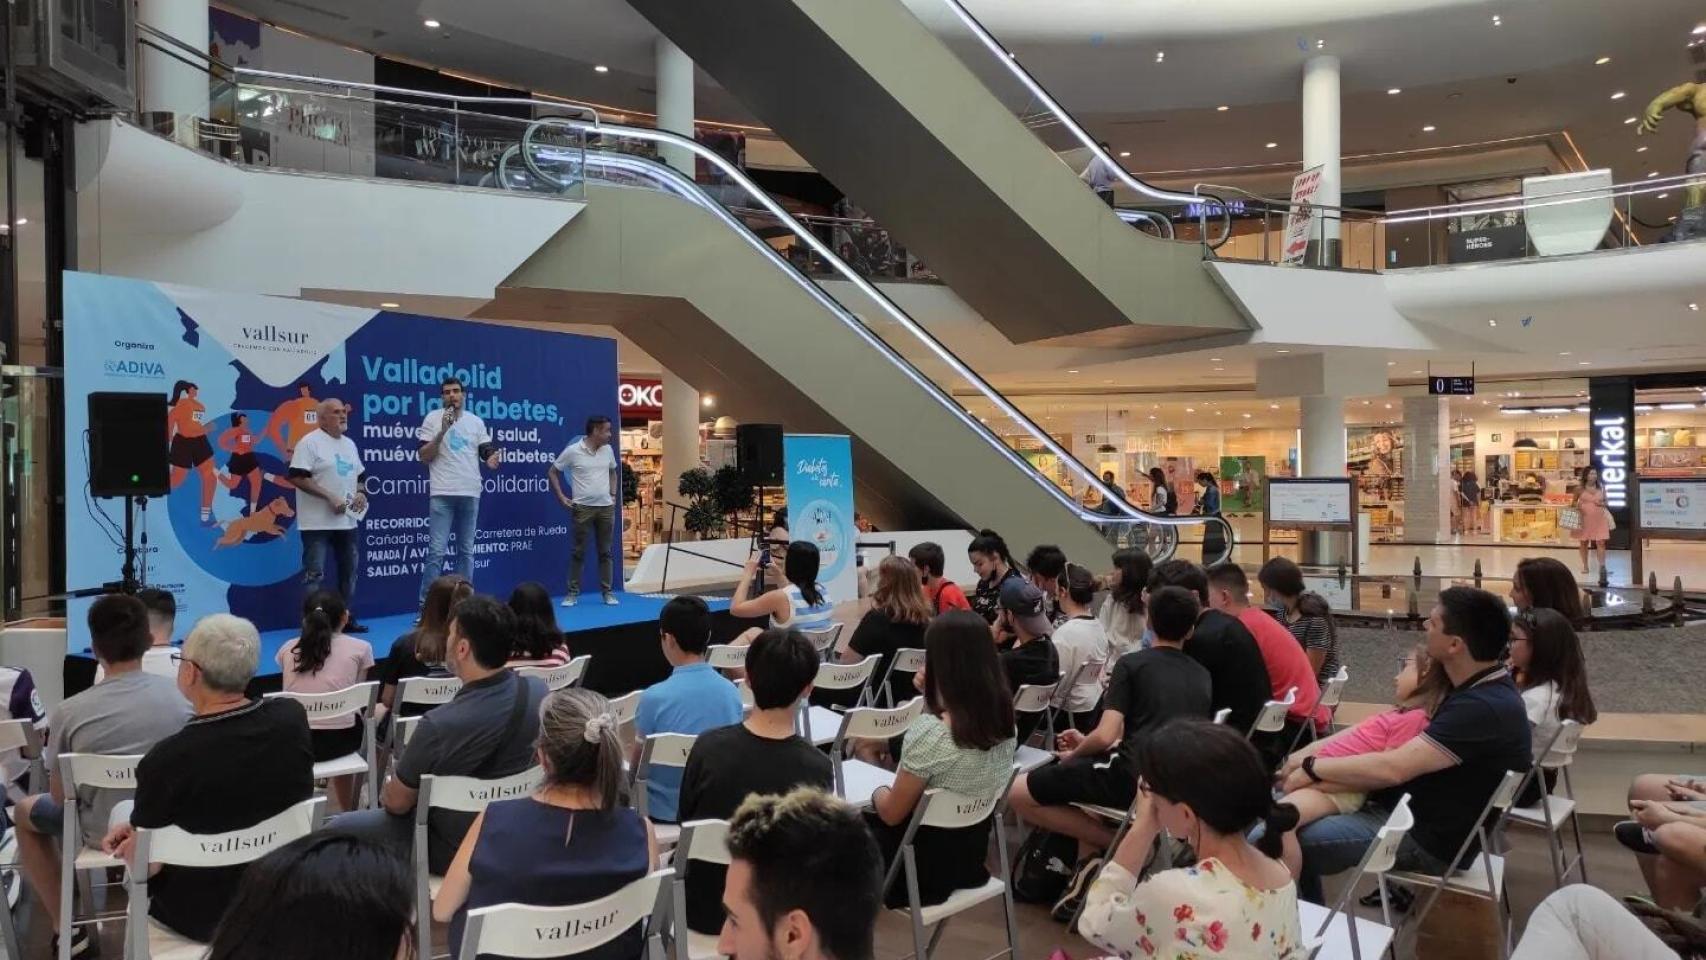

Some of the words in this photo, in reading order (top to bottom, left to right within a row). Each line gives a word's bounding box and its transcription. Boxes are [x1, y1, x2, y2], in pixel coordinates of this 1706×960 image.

[242, 325, 309, 344] vallsur
[114, 340, 155, 351] Organiza
[361, 355, 502, 391] Valladolid
[1436, 378, 1445, 393] 0
[363, 393, 413, 423] por
[466, 393, 564, 426] iabetes,
[363, 421, 423, 438] muéve
[497, 427, 541, 444] salud,
[1594, 416, 1626, 506] merkal
[366, 532, 414, 546] Cañada
[474, 528, 522, 539] Carretera
[524, 526, 536, 537] de
[538, 525, 567, 535] Rueda
[367, 550, 400, 561] PARADA
[511, 541, 533, 551] PRAE
[366, 564, 409, 577] SALIDA
[411, 563, 419, 574] Y
[304, 700, 346, 712] allsur
[469, 782, 531, 800] vallsur
[200, 831, 277, 853] vallsur
[536, 909, 620, 940] vallsur
